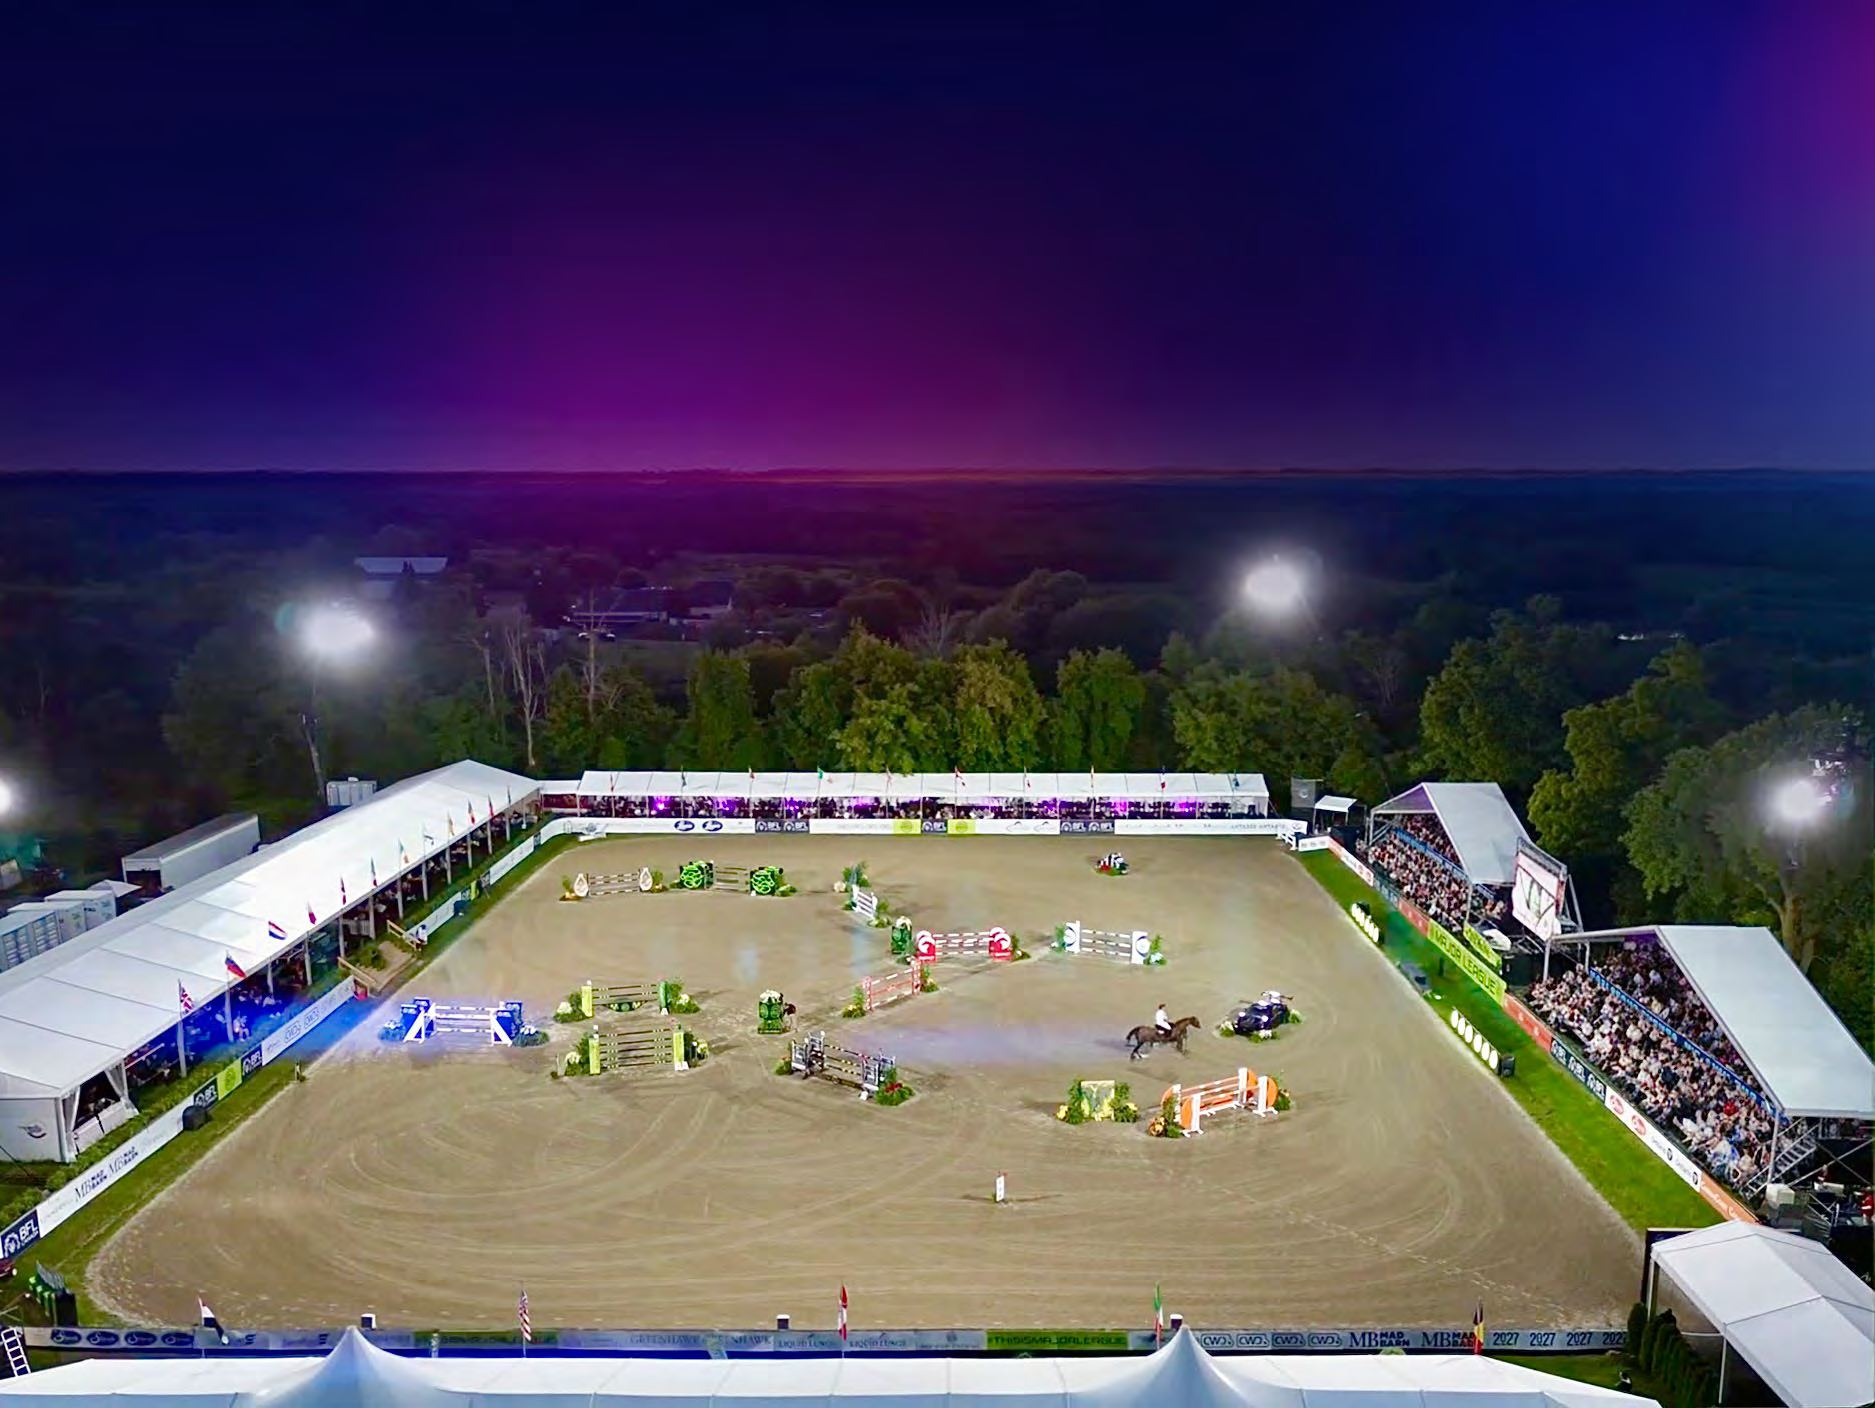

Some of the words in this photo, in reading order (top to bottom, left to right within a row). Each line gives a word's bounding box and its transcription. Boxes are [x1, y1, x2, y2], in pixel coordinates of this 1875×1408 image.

[19, 1218, 39, 1241] BFL
[1349, 1331, 1379, 1348] MB
[1379, 1331, 1405, 1340] MAD
[1379, 1339, 1410, 1347] BARN
[1421, 1331, 1451, 1348] MB
[1493, 1331, 1520, 1347] 2027
[1530, 1331, 1556, 1347] 2027
[1566, 1331, 1593, 1347] 2027
